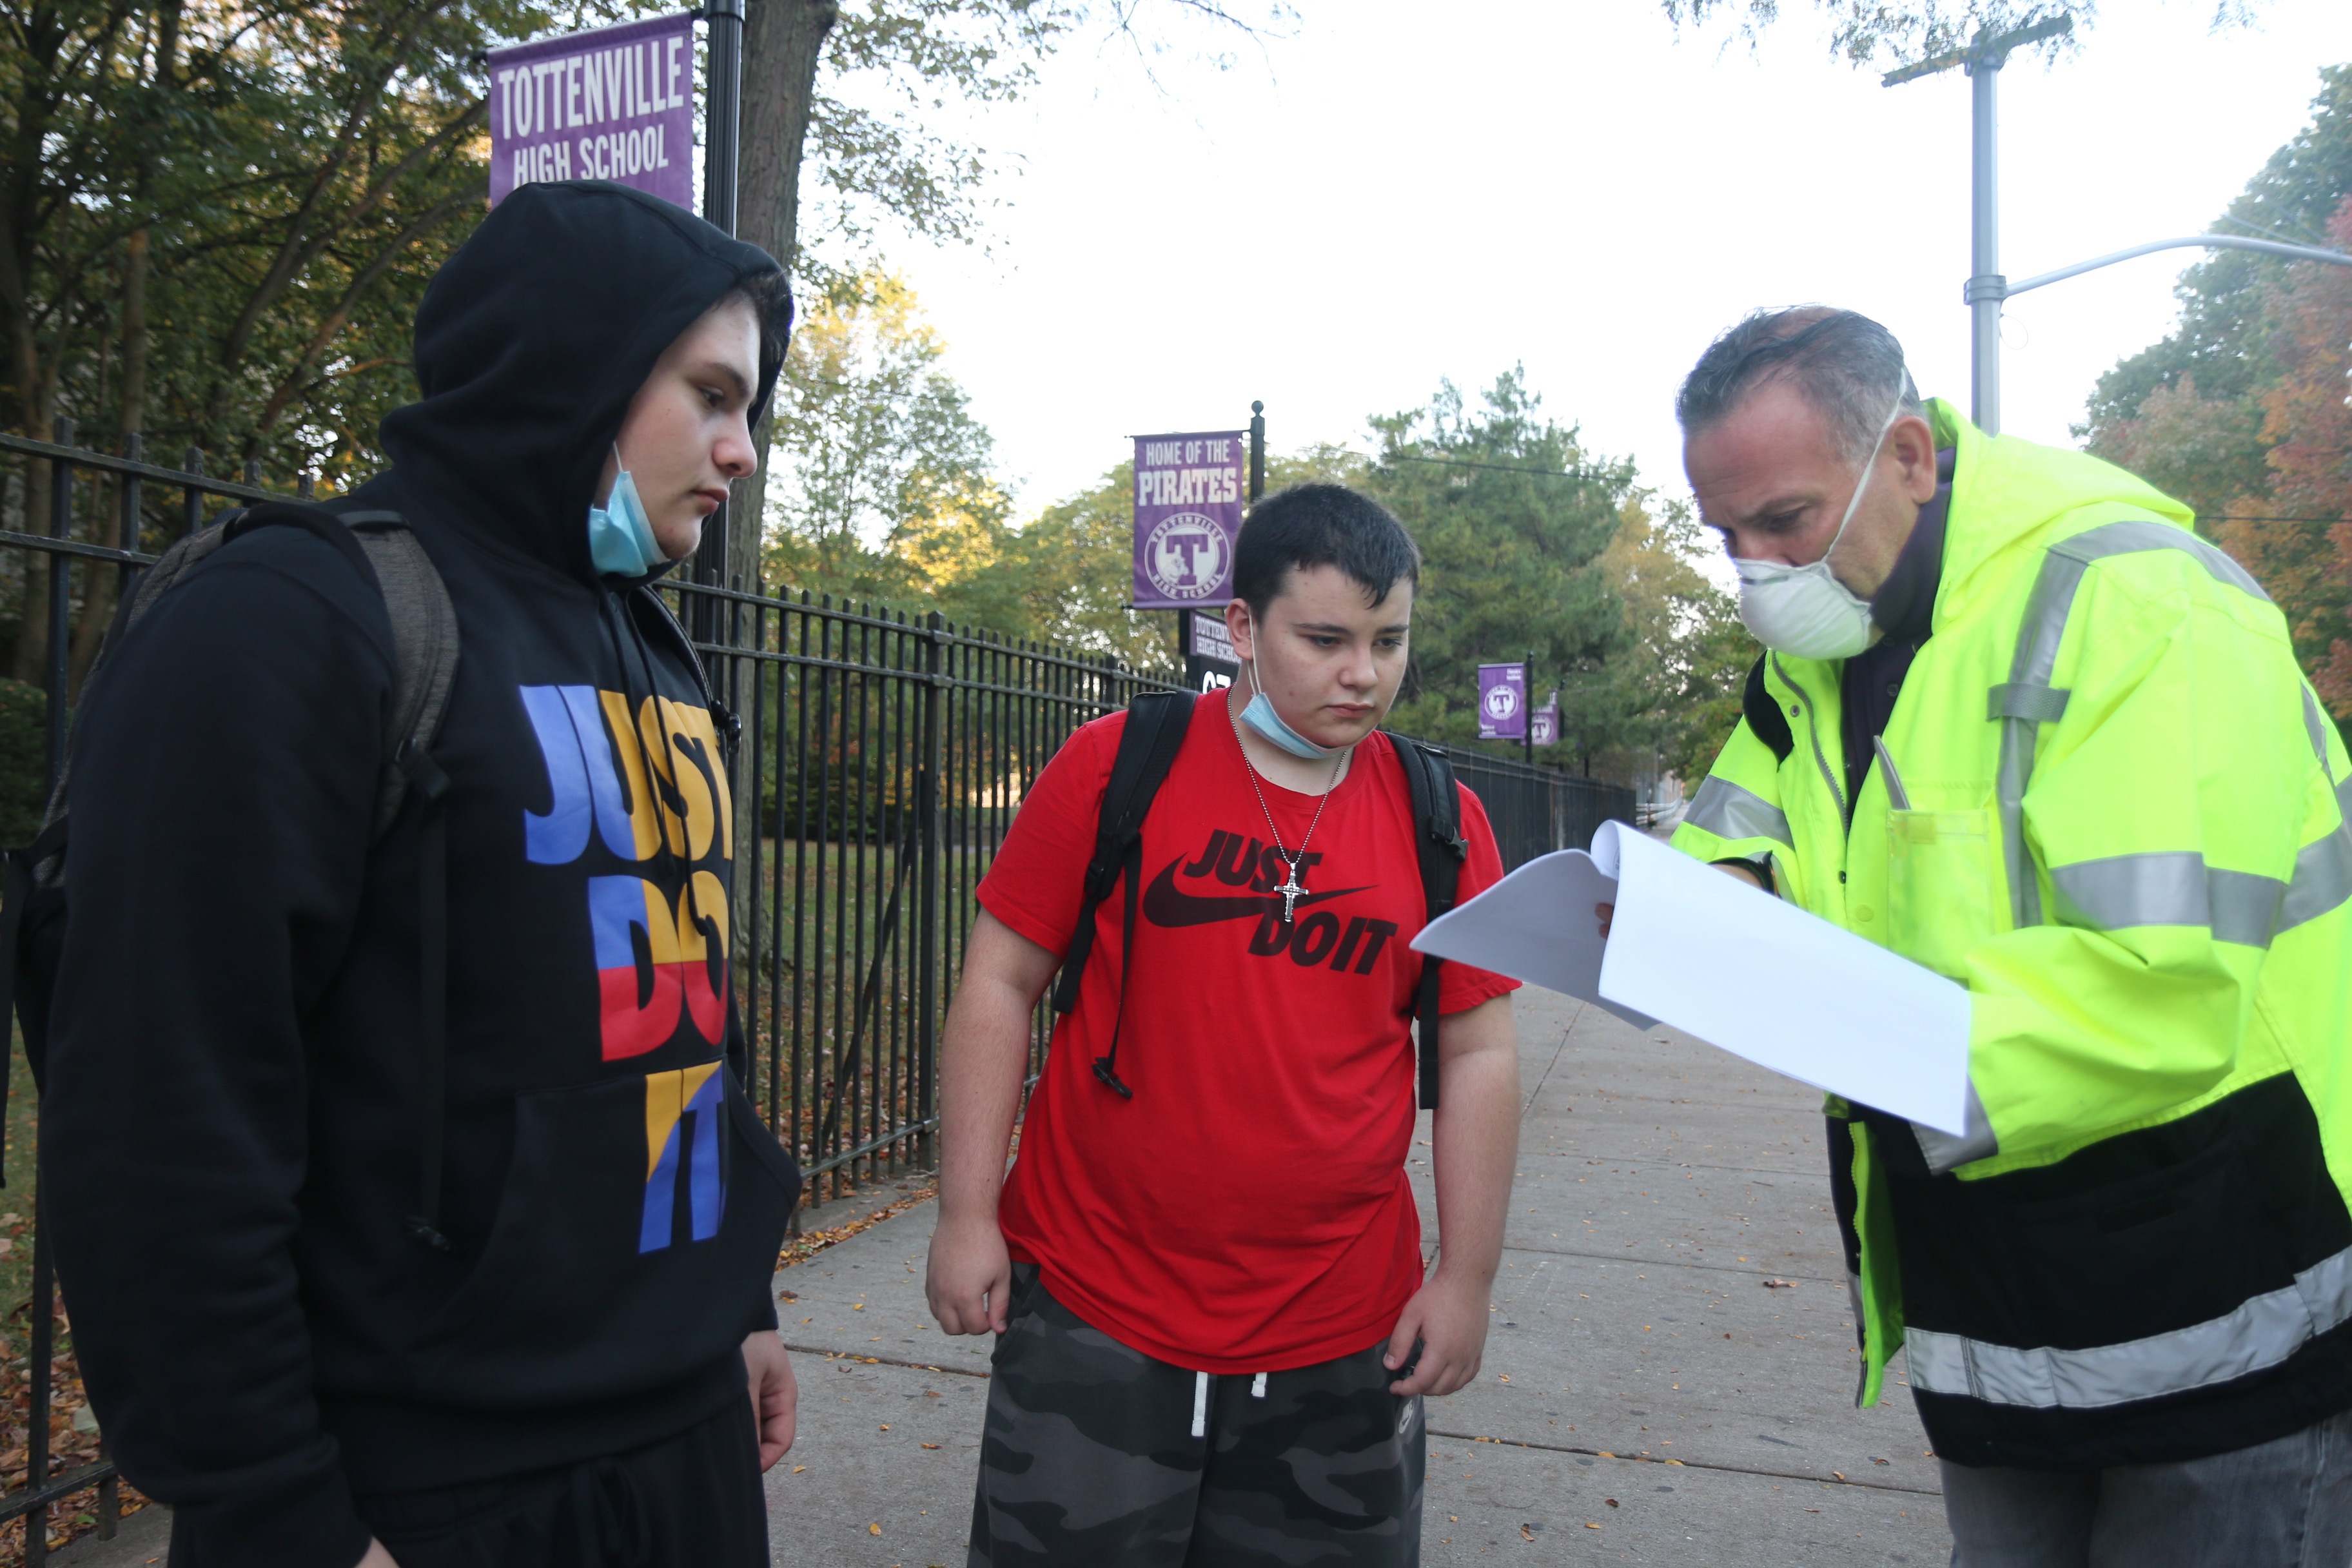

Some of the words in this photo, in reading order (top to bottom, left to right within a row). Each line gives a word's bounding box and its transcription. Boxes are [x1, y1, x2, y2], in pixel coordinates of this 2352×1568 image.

[498, 36, 684, 140] TOTTENVILLE
[513, 141, 572, 190] HIGH
[580, 123, 669, 180] SCHOOL
[1146, 442, 1182, 467] HOME
[1185, 440, 1202, 465] OF
[1205, 439, 1231, 463] THE
[1138, 467, 1237, 507] PIRATES
[1197, 636, 1217, 658] HIGH
[520, 685, 733, 865] JUST
[1182, 828, 1324, 894] JUST
[588, 870, 729, 1063] DO
[638, 1060, 727, 1253] IT
